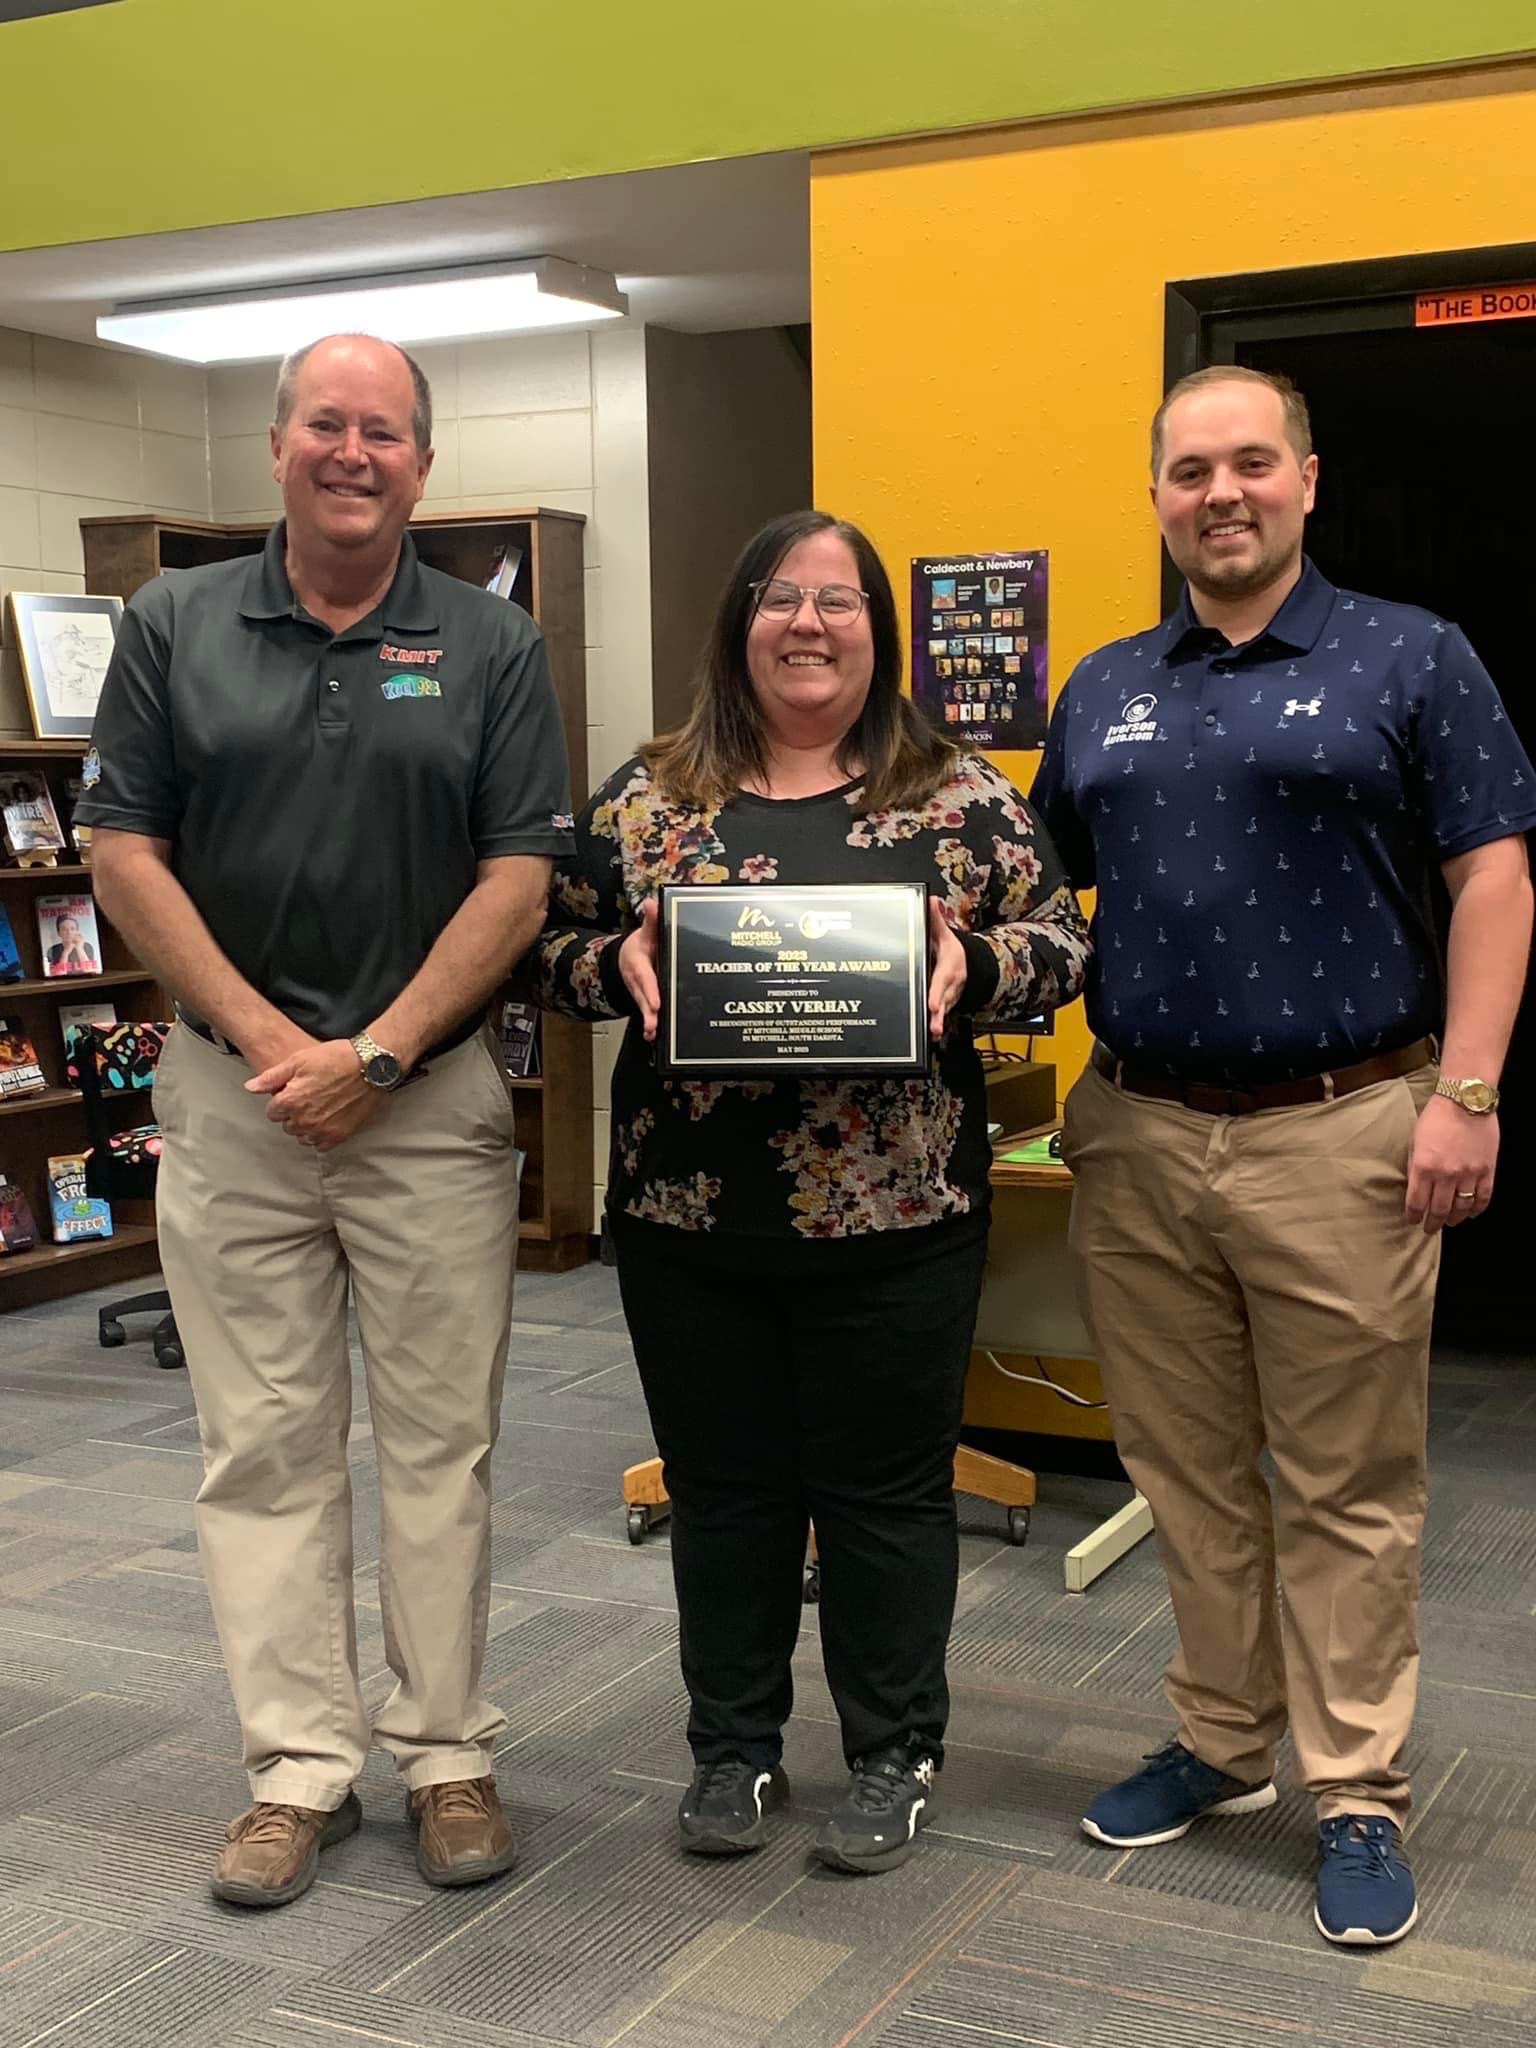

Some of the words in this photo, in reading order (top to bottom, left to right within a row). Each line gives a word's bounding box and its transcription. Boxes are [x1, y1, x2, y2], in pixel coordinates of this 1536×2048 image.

[1482, 293, 1536, 315] BOO
[923, 562, 975, 575] Caldecott
[976, 561, 985, 571] &
[986, 558, 1034, 571] Newbery
[731, 931, 781, 940] MITCHELL
[696, 962, 753, 973] TEACHER
[755, 962, 773, 972] OF
[774, 962, 800, 972] THE
[801, 962, 837, 972] YEAR
[838, 961, 891, 972] AWARD
[724, 1001, 786, 1014] CASSEY
[790, 1000, 861, 1013] VERHAY
